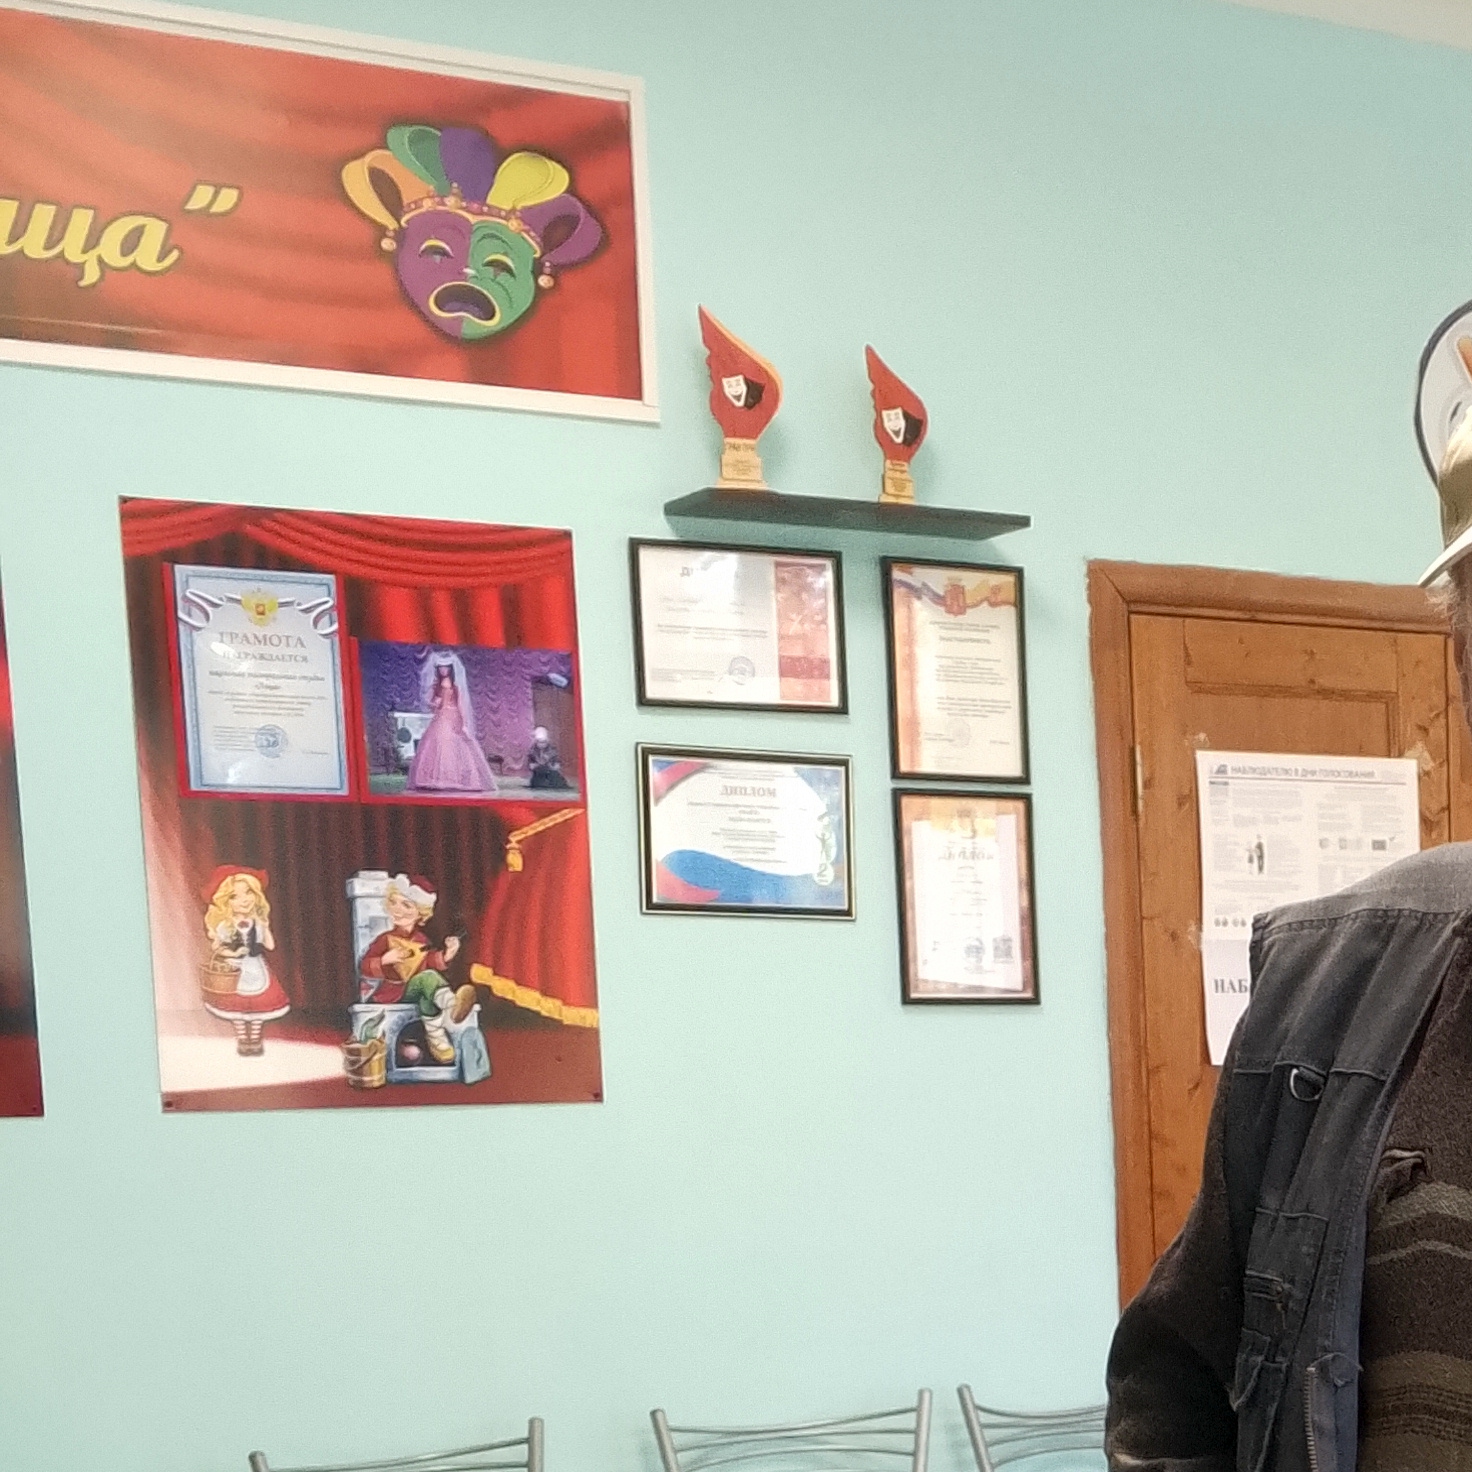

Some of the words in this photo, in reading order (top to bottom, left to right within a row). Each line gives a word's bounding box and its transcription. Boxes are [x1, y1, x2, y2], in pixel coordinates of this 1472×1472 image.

[218, 631, 307, 649] ГРАМОТА
[222, 651, 309, 664] НГРАЖДАЕТСЯ
[719, 785, 777, 798] ДИПЛОМ
[1213, 978, 1249, 994] НАБ
